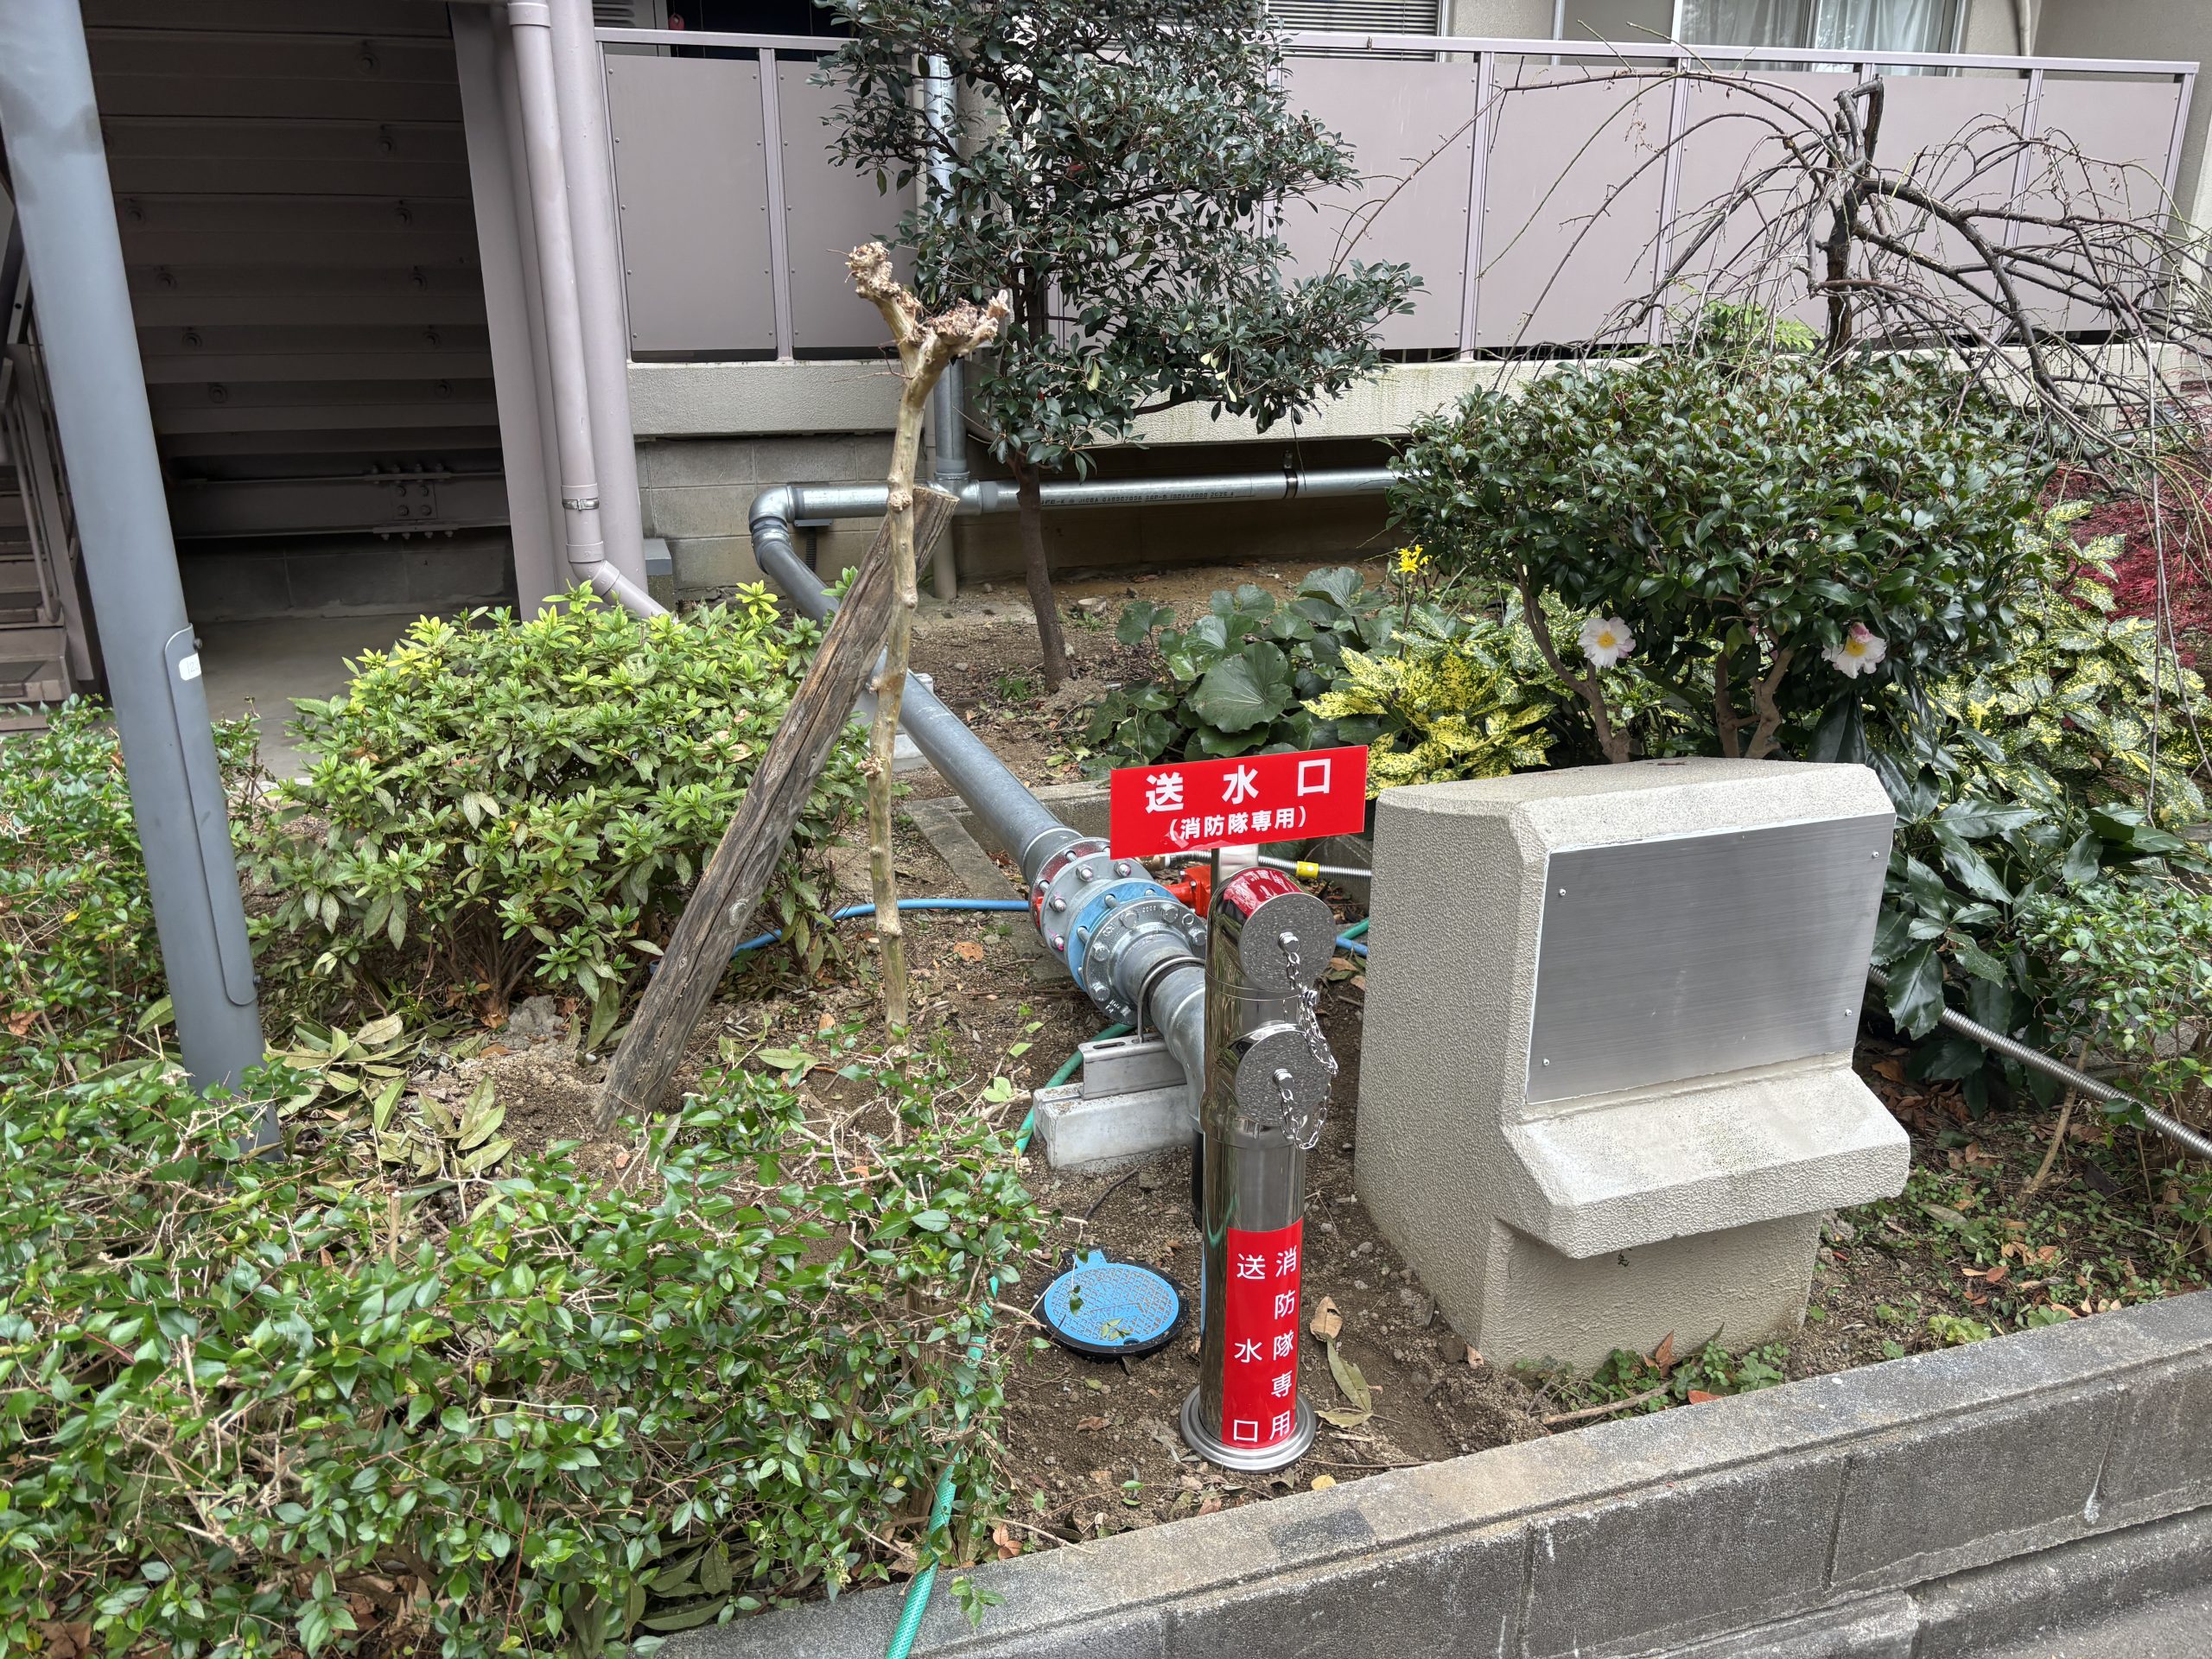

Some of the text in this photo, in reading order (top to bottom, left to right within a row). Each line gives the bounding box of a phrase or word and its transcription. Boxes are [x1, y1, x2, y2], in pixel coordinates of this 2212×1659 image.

[1145, 758, 1332, 814] 送水口
[1233, 1253, 1266, 1443] 送水口
[1268, 1244, 1298, 1441] 消防隊専用
